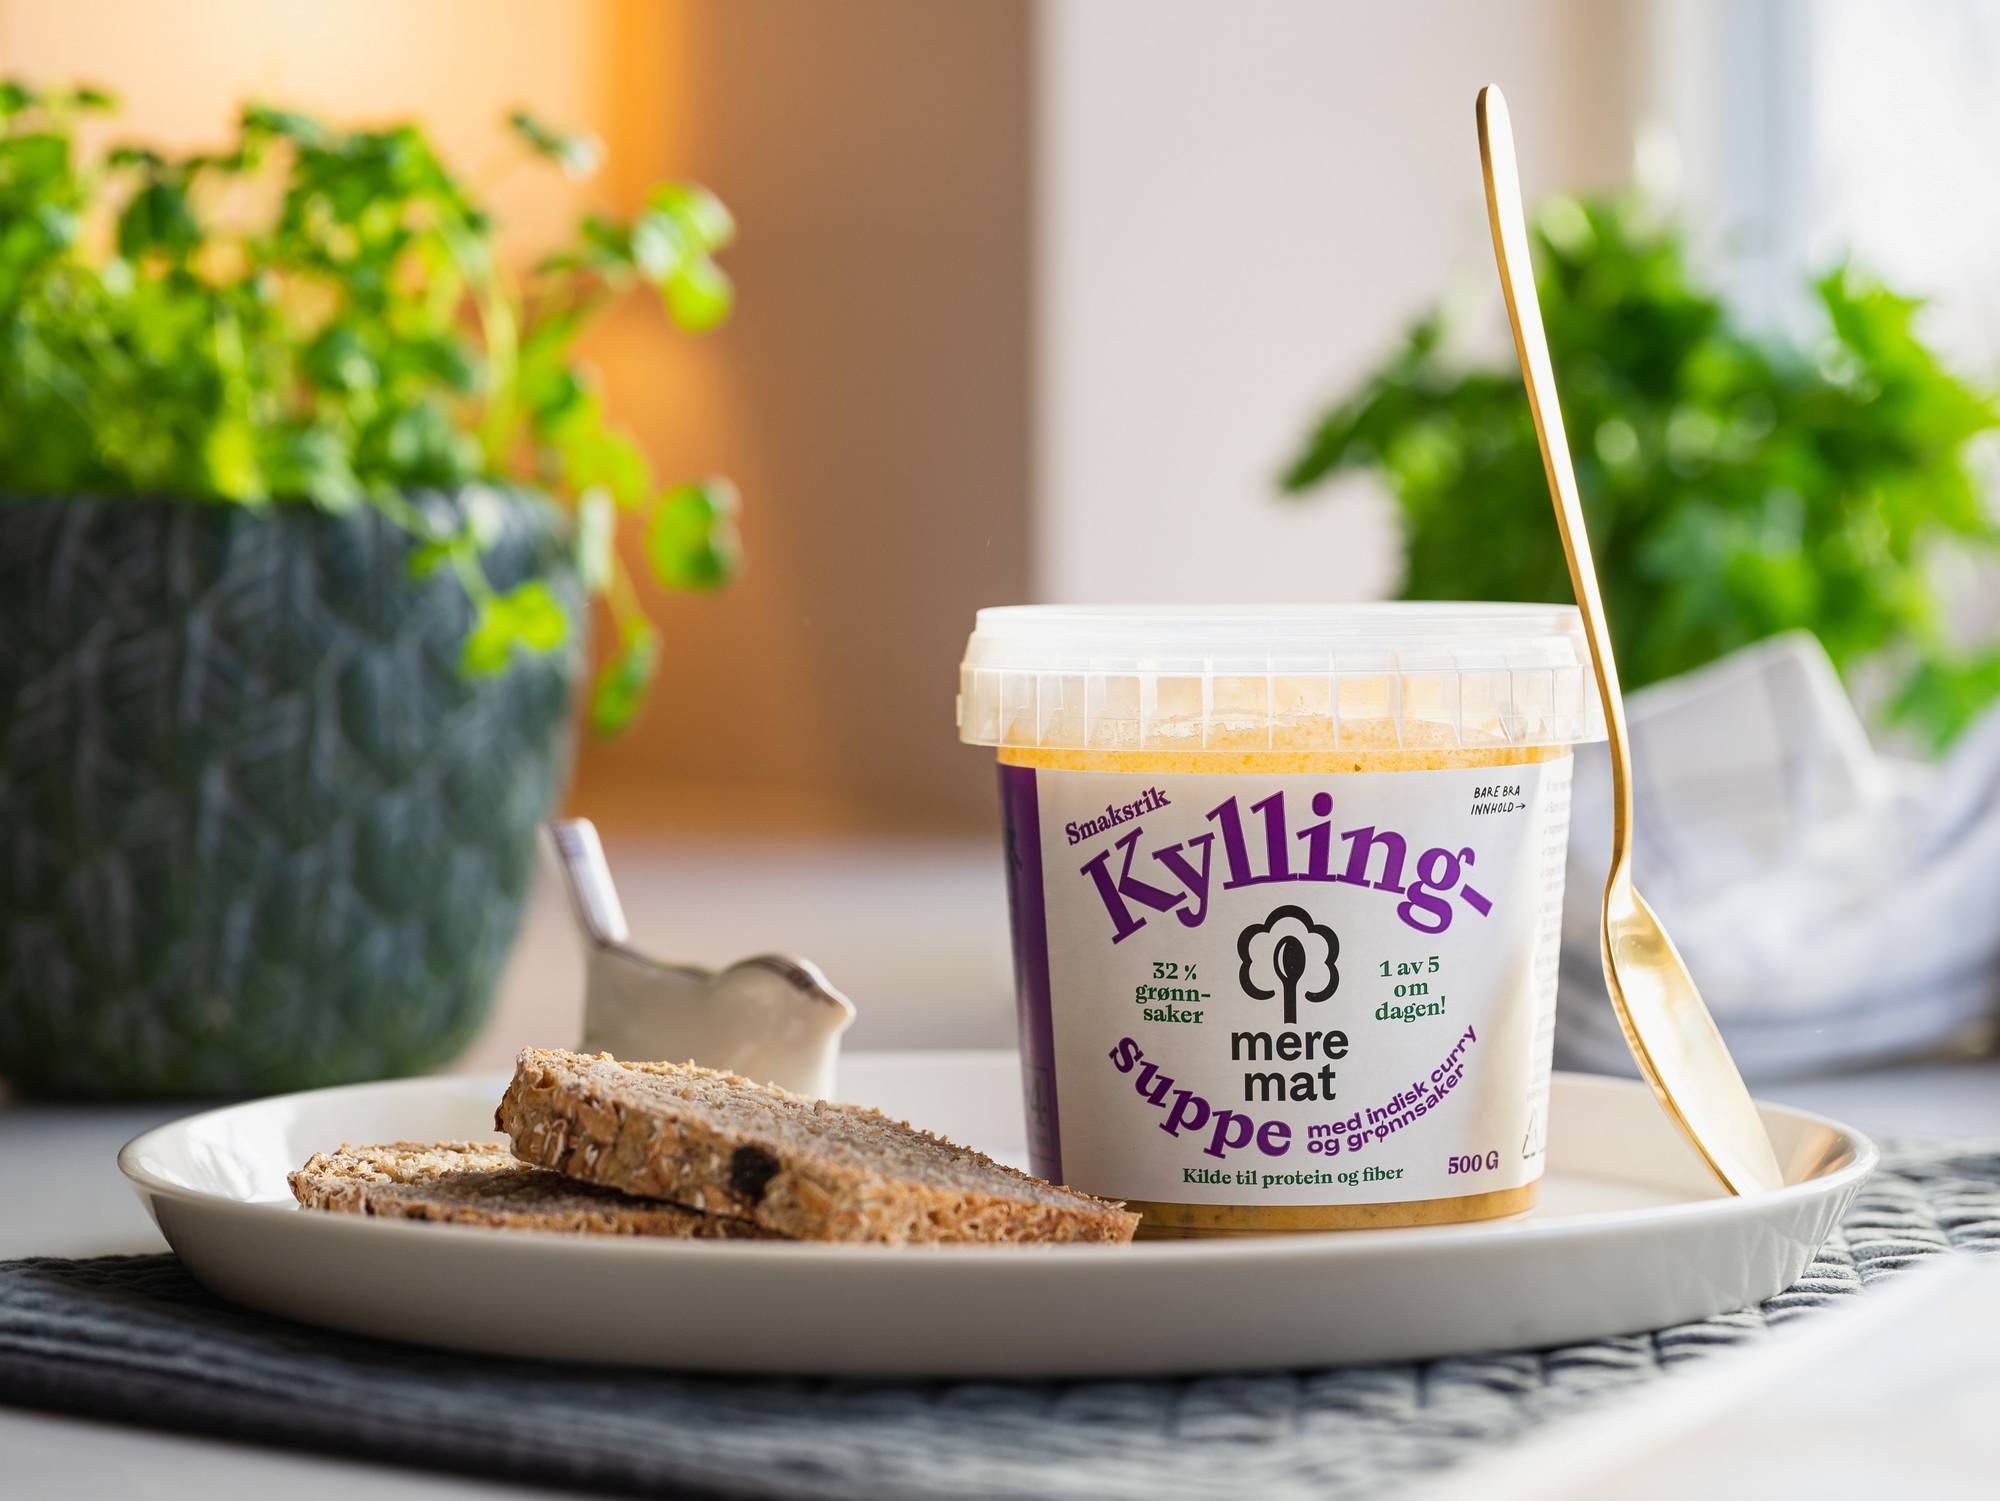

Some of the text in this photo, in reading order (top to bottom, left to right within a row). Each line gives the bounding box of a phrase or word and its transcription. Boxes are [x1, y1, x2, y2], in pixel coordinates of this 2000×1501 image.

[1474, 785, 1520, 799] BARE BRA
[1065, 786, 1171, 846] Smaksrik
[1471, 801, 1514, 815] INNHOLD
[1080, 790, 1493, 945] Kylling-
[1152, 962, 1197, 981] 32 %
[1379, 955, 1440, 977] 1 av 5
[1135, 984, 1211, 1004] grønn-
[1393, 982, 1429, 998] om
[1143, 1004, 1204, 1024] saker
[1375, 995, 1446, 1023] dagen!
[1231, 1030, 1349, 1061] mere
[1244, 1063, 1337, 1102] mat
[1307, 1024, 1477, 1138] med indisk curry
[1108, 1037, 1292, 1159] suppe
[1307, 1063, 1464, 1156] og grønnsaker
[1448, 1150, 1499, 1175] 500 G
[1182, 1166, 1404, 1189] Kilde til protein og fiber
